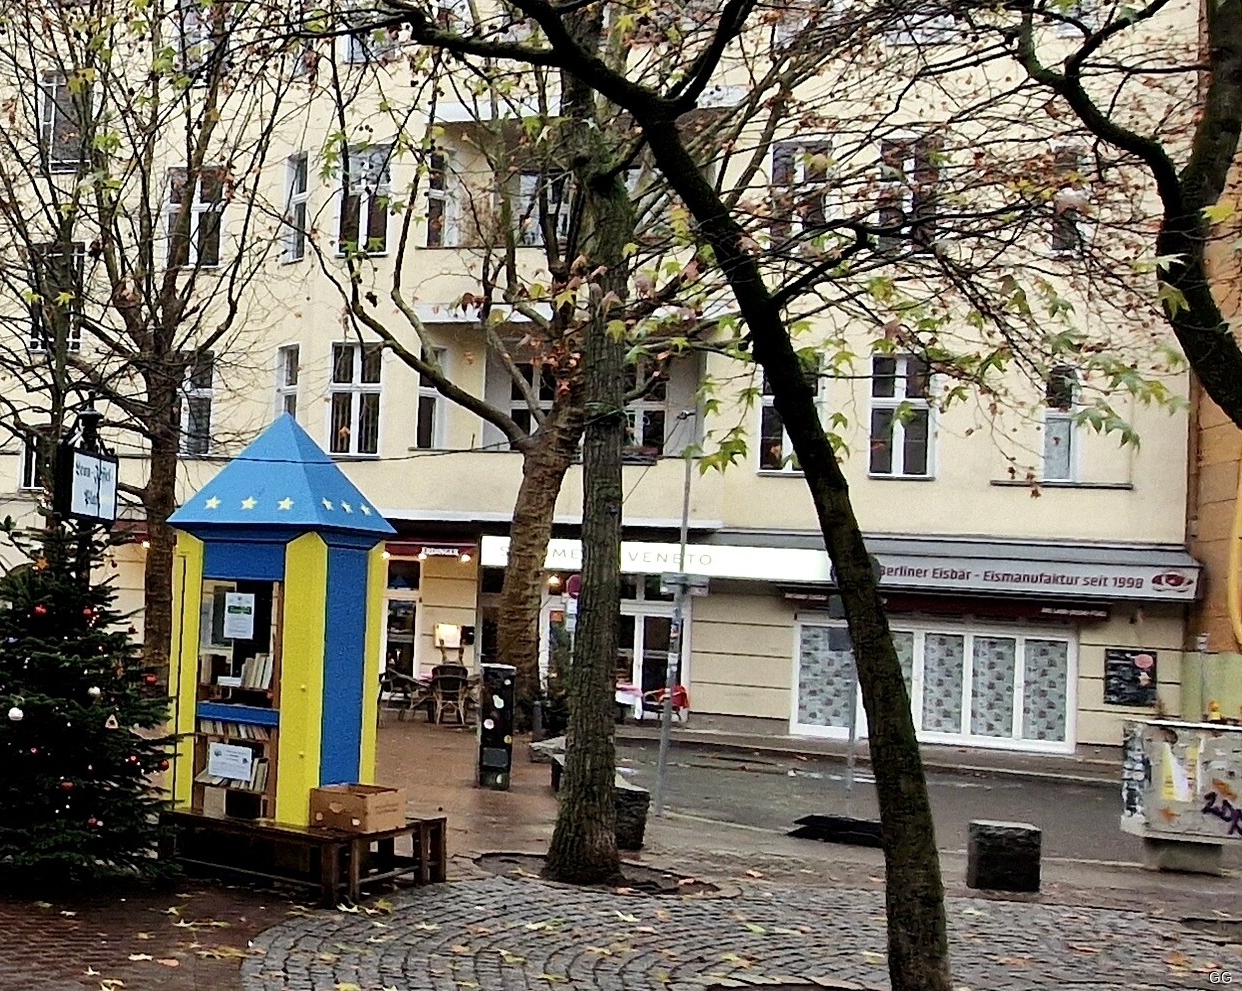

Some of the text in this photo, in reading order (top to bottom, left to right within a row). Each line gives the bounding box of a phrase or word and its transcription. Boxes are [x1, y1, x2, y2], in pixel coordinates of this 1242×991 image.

[628, 550, 712, 566] VENETO
[879, 565, 928, 578] Berliner
[983, 570, 1080, 586] Eismanufaktur
[1083, 575, 1109, 587] seit
[1112, 576, 1144, 589] 1998
